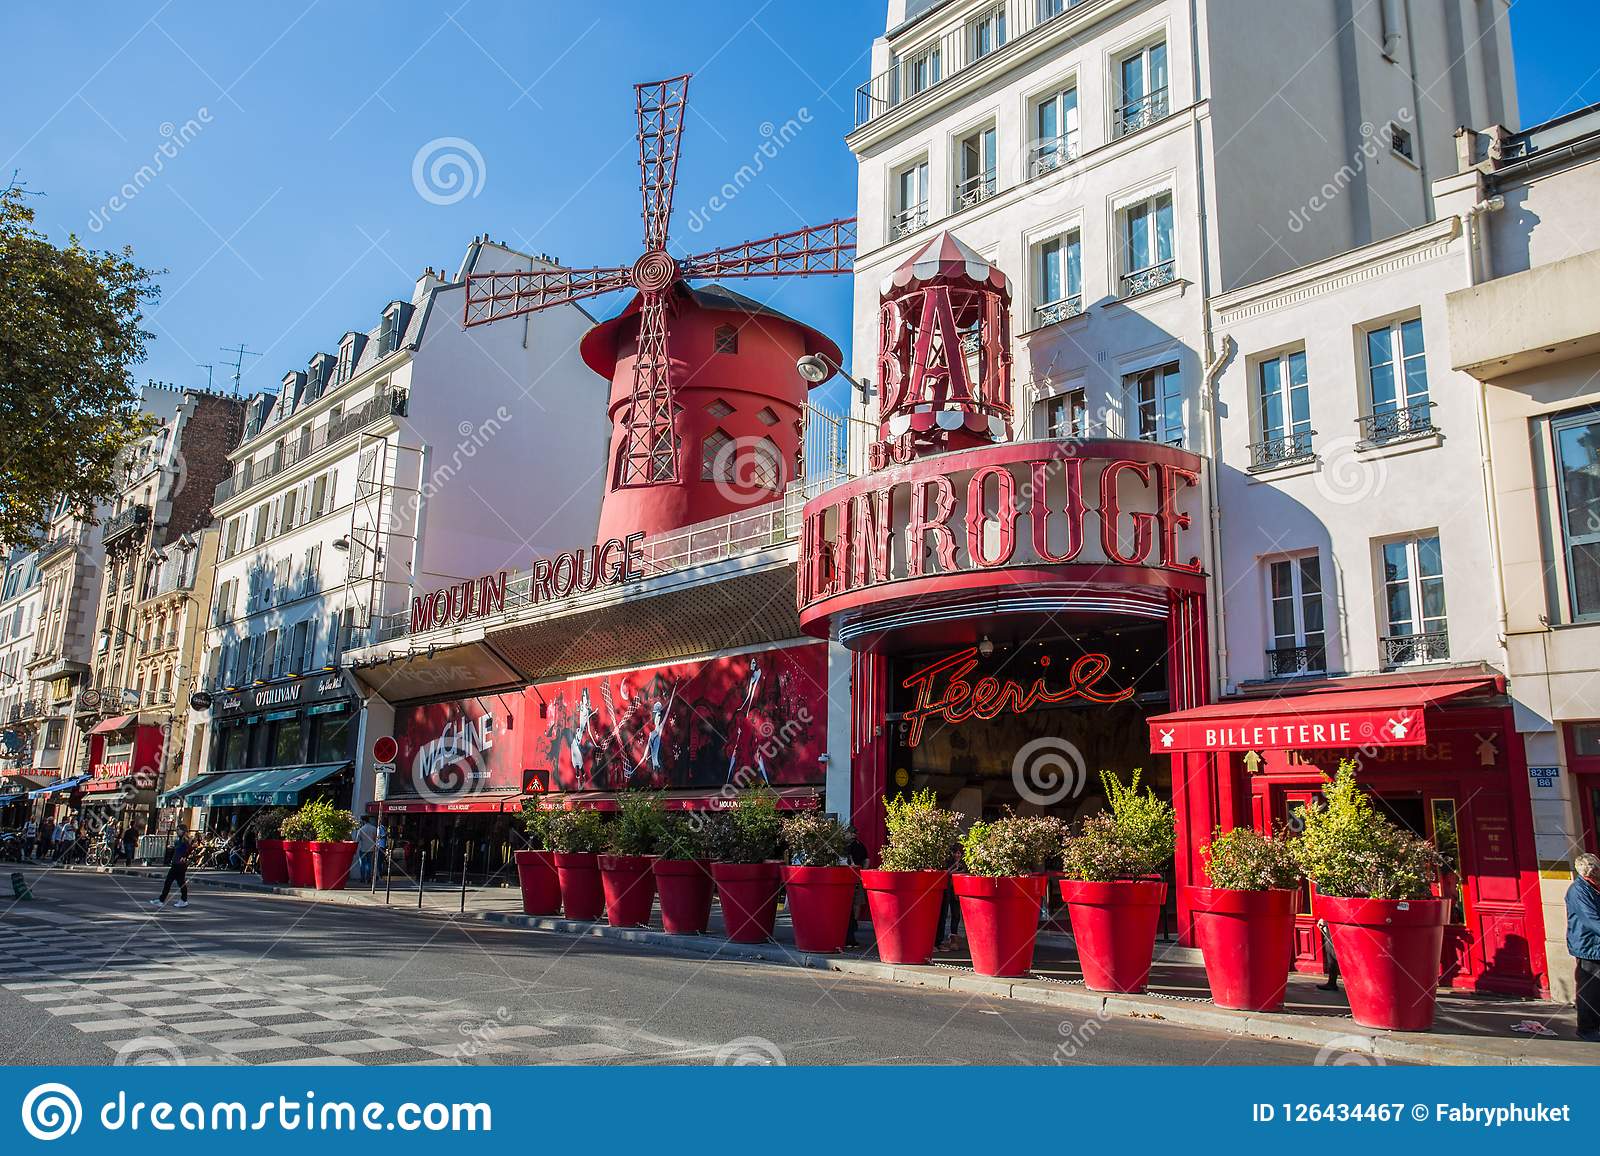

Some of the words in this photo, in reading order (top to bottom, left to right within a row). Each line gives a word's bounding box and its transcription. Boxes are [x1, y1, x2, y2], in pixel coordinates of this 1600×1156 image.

[906, 458, 1200, 577] ROUGE
[410, 571, 507, 634] MOULIN
[532, 530, 646, 604] ROUGE
[903, 647, 1135, 748] Féerie
[1206, 722, 1351, 746] BILLETTERIE
[1531, 769, 1542, 777] 82
